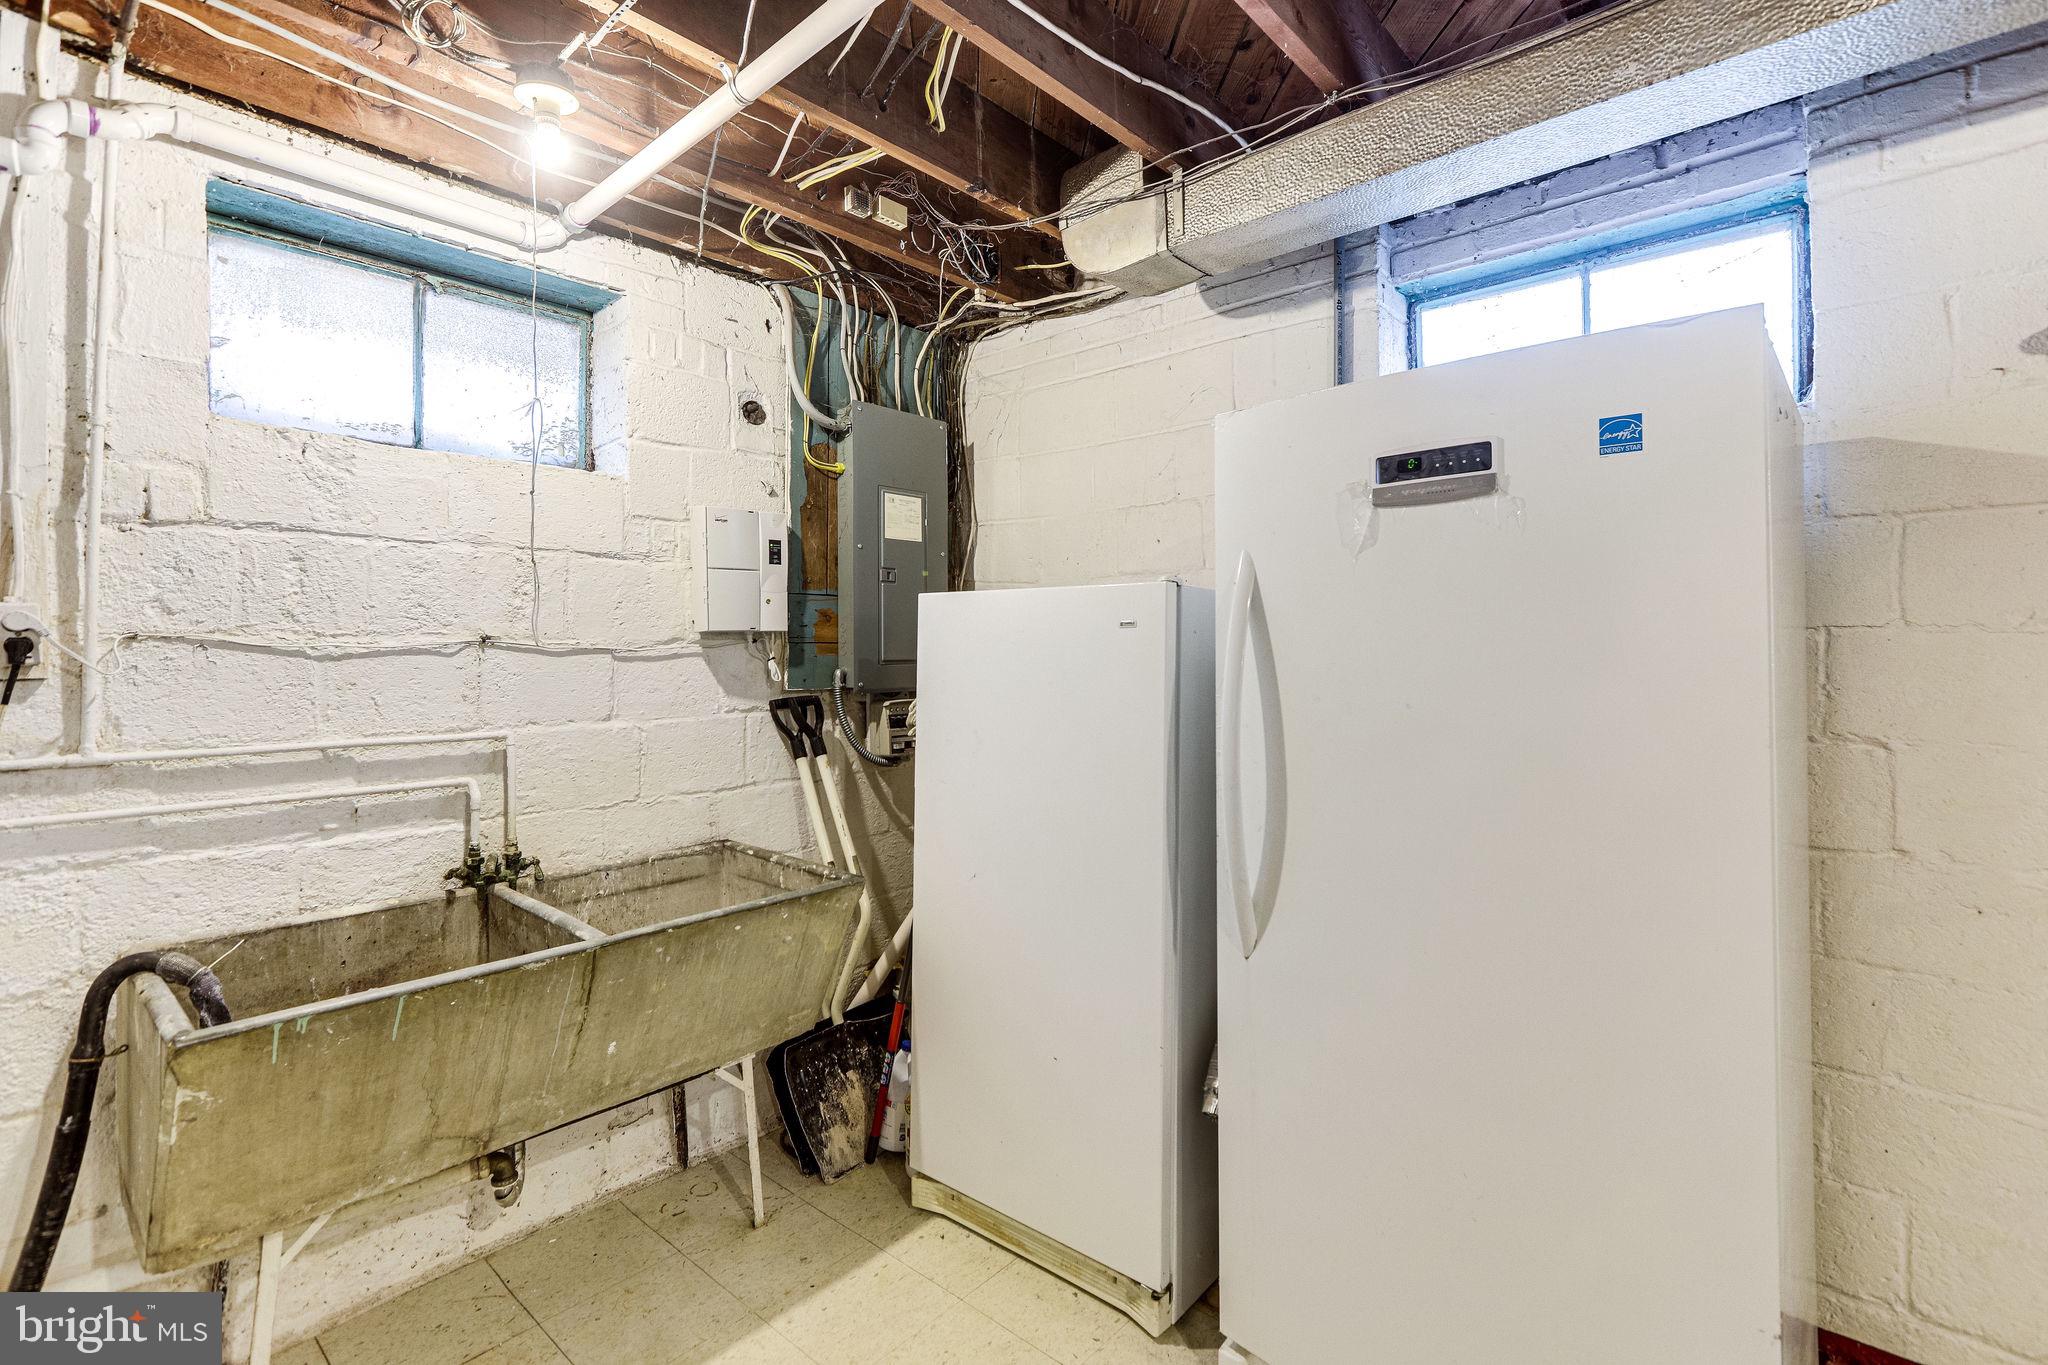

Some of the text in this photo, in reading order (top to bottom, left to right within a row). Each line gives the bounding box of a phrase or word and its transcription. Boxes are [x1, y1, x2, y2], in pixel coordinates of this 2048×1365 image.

[1336, 299, 1343, 310] 40
[1600, 444, 1642, 455] ENERGY STAR
